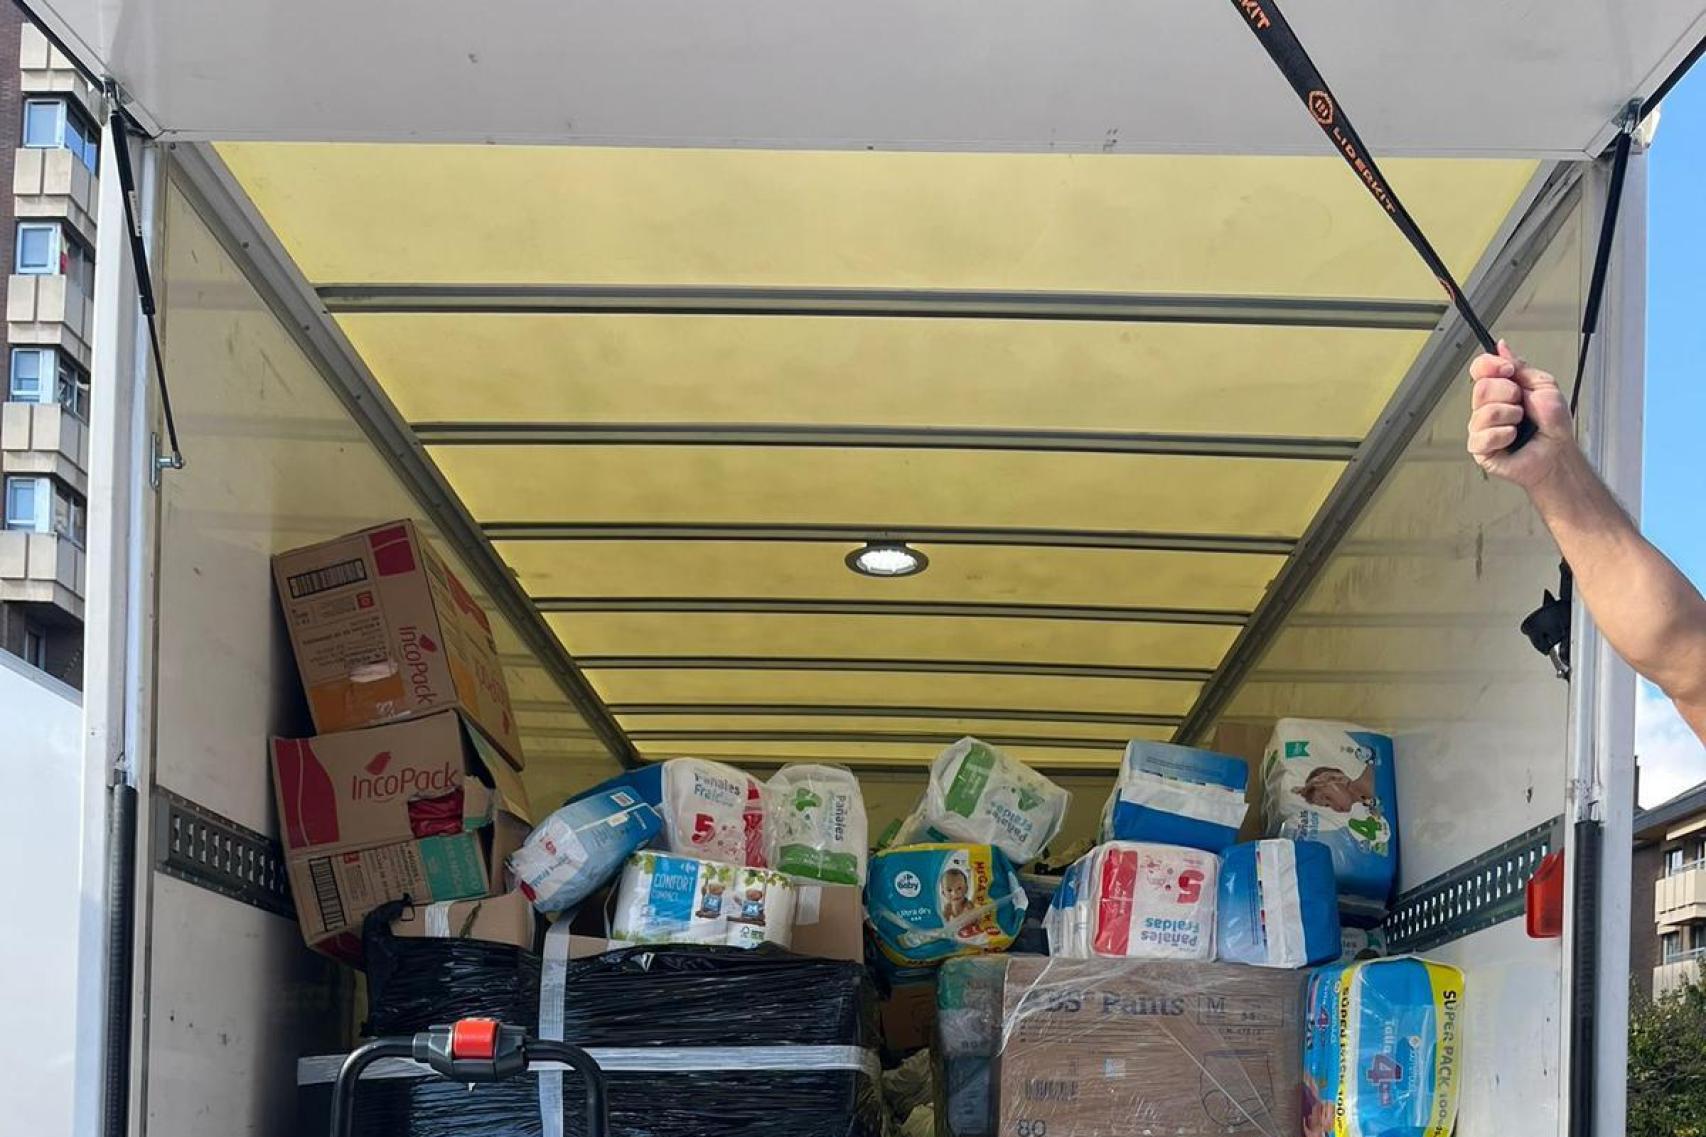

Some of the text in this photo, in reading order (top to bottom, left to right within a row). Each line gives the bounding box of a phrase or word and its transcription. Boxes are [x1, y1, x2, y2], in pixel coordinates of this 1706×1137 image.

[1333, 127, 1396, 213] LIDERKIT
[399, 625, 437, 705] IncoPack
[352, 762, 459, 801] IncoPack
[653, 873, 694, 894] COMFORT
[1176, 869, 1205, 905] 5
[1140, 930, 1198, 948] Pañales
[1145, 917, 1200, 933] Fraldas
[1439, 1046, 1454, 1088] PACK
[1017, 1120, 1046, 1137] 80
